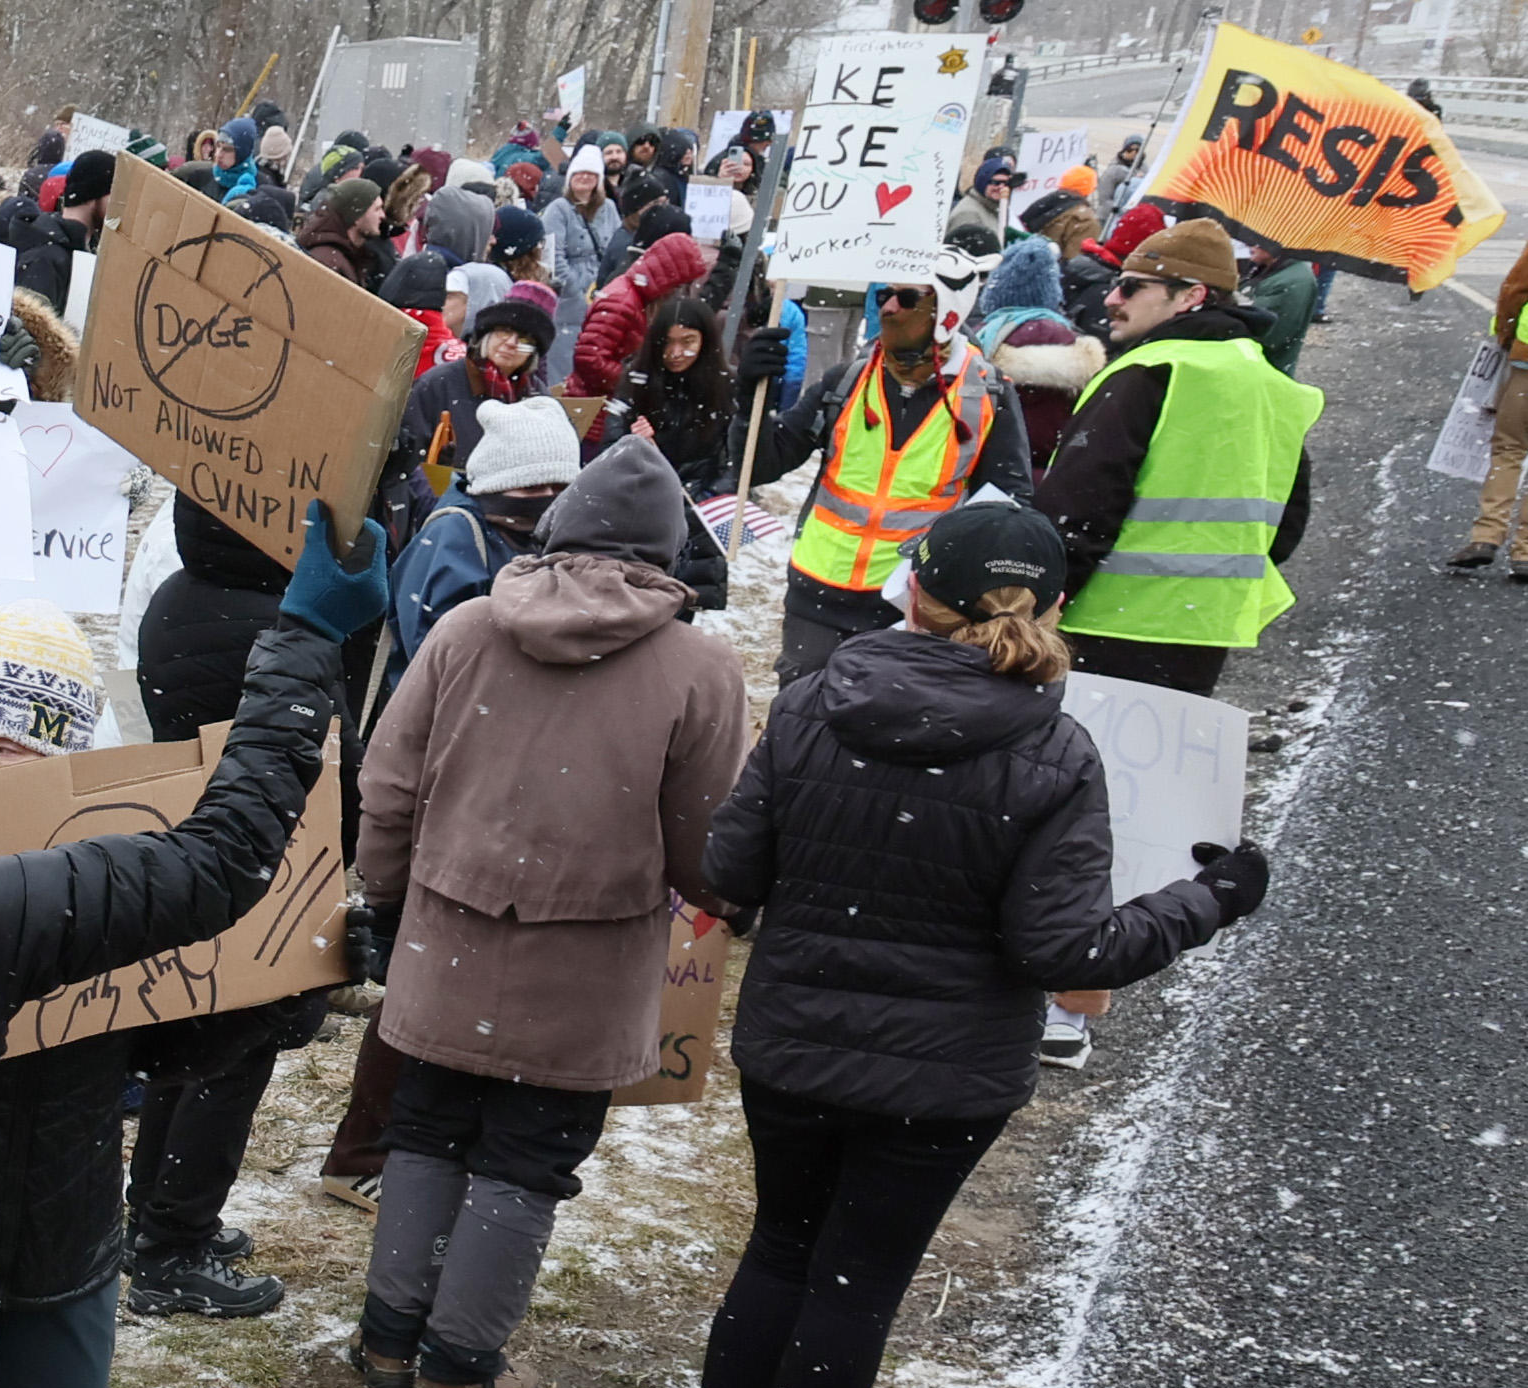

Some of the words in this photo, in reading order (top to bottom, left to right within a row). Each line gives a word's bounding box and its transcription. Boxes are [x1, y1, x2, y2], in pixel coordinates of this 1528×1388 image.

[794, 125, 899, 167] ISE
[1200, 68, 1465, 227] RESIS
[288, 452, 329, 491] IN
[28, 702, 71, 748] M
